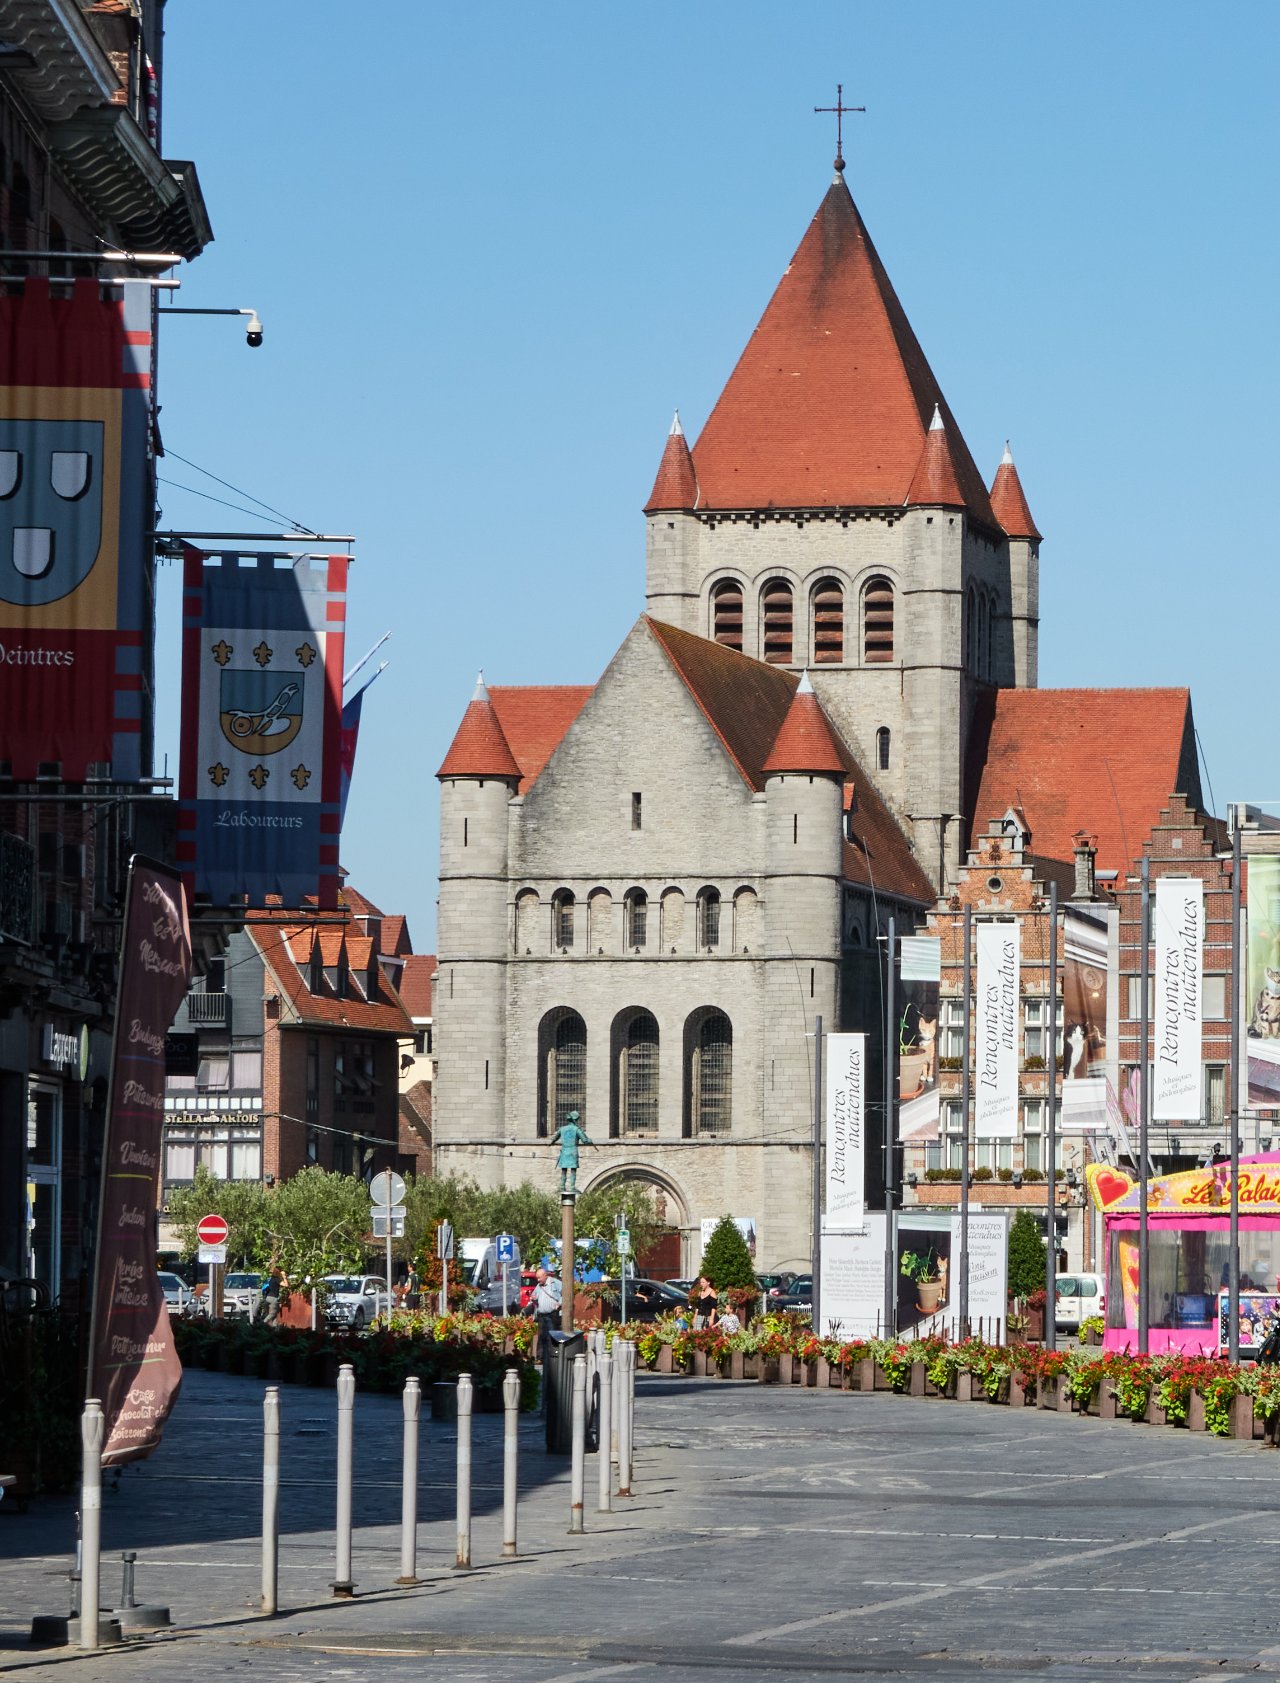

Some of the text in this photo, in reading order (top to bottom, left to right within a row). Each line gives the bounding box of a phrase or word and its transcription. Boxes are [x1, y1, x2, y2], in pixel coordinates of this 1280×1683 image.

[213, 810, 303, 828] Laboureurs
[998, 940, 1015, 1050] inattendues
[1160, 947, 1181, 1066] Rencontres
[1178, 898, 1197, 1021] inattendues
[981, 984, 999, 1090] Rencontres
[165, 1110, 259, 1123] STELLA ARTOIS
[831, 1089, 847, 1184] Rencontres
[845, 1049, 860, 1149] inattendues
[957, 1220, 1002, 1231] ncontres
[1182, 1179, 1215, 1204] Le
[500, 1237, 510, 1251] P
